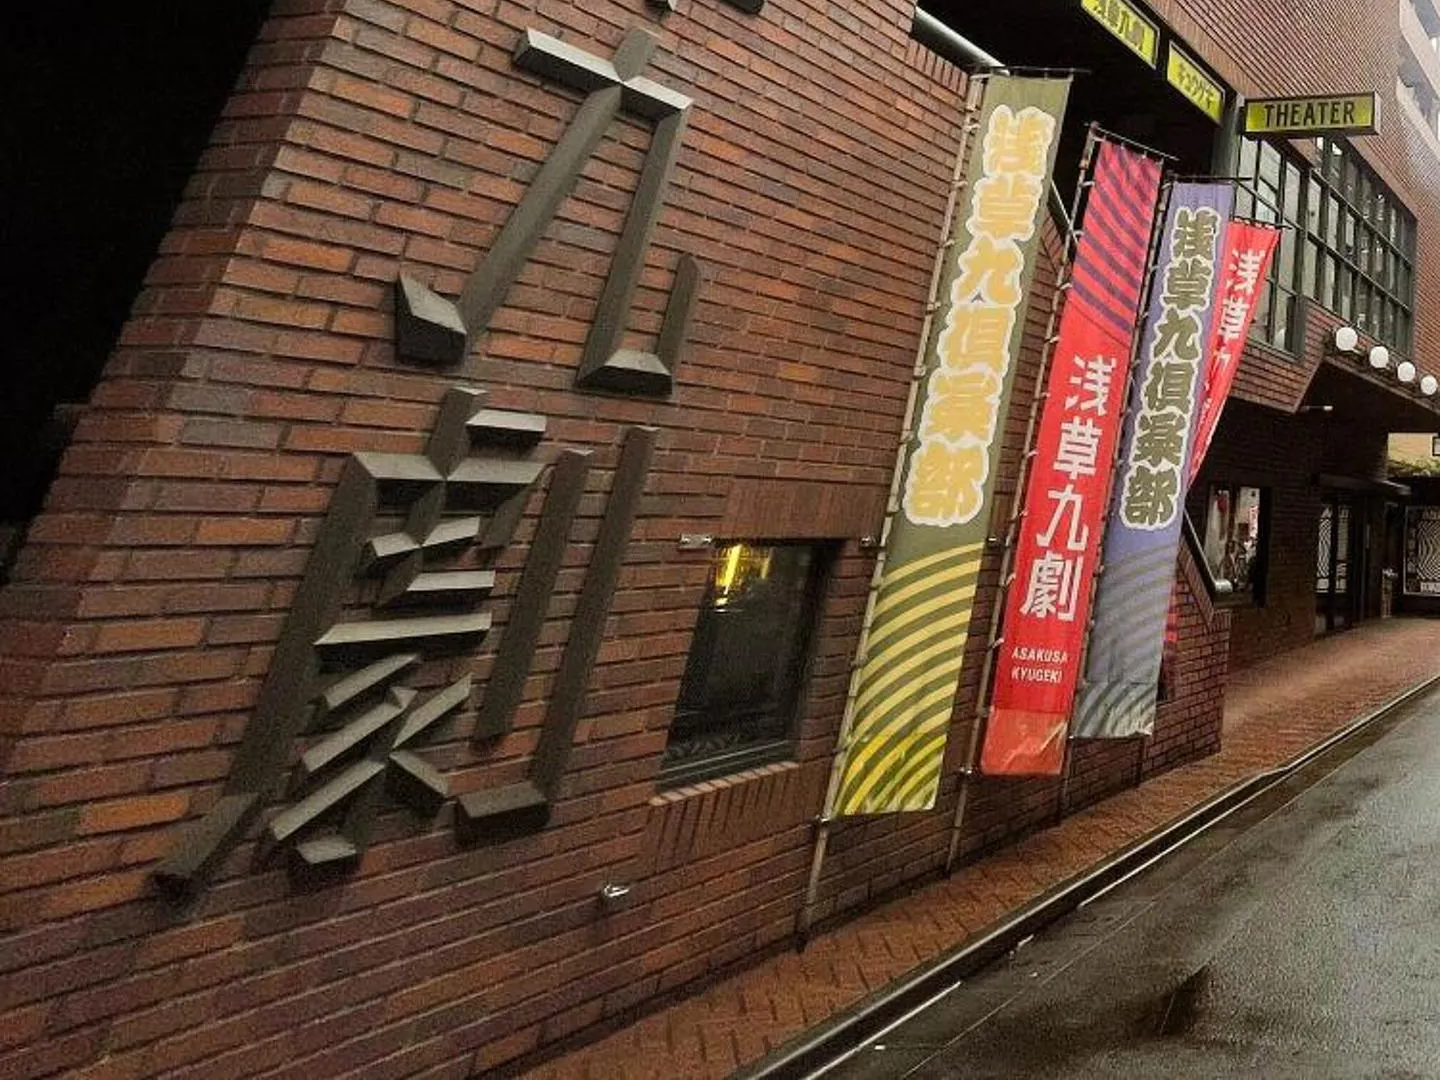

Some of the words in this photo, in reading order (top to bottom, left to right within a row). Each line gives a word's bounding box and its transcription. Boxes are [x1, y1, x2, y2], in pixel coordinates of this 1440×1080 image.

[1263, 99, 1356, 128] THEATER
[1019, 355, 1117, 621] 浅草九劇
[1011, 647, 1068, 665] ASAKUSA
[1011, 666, 1063, 683] KYUGEKI
